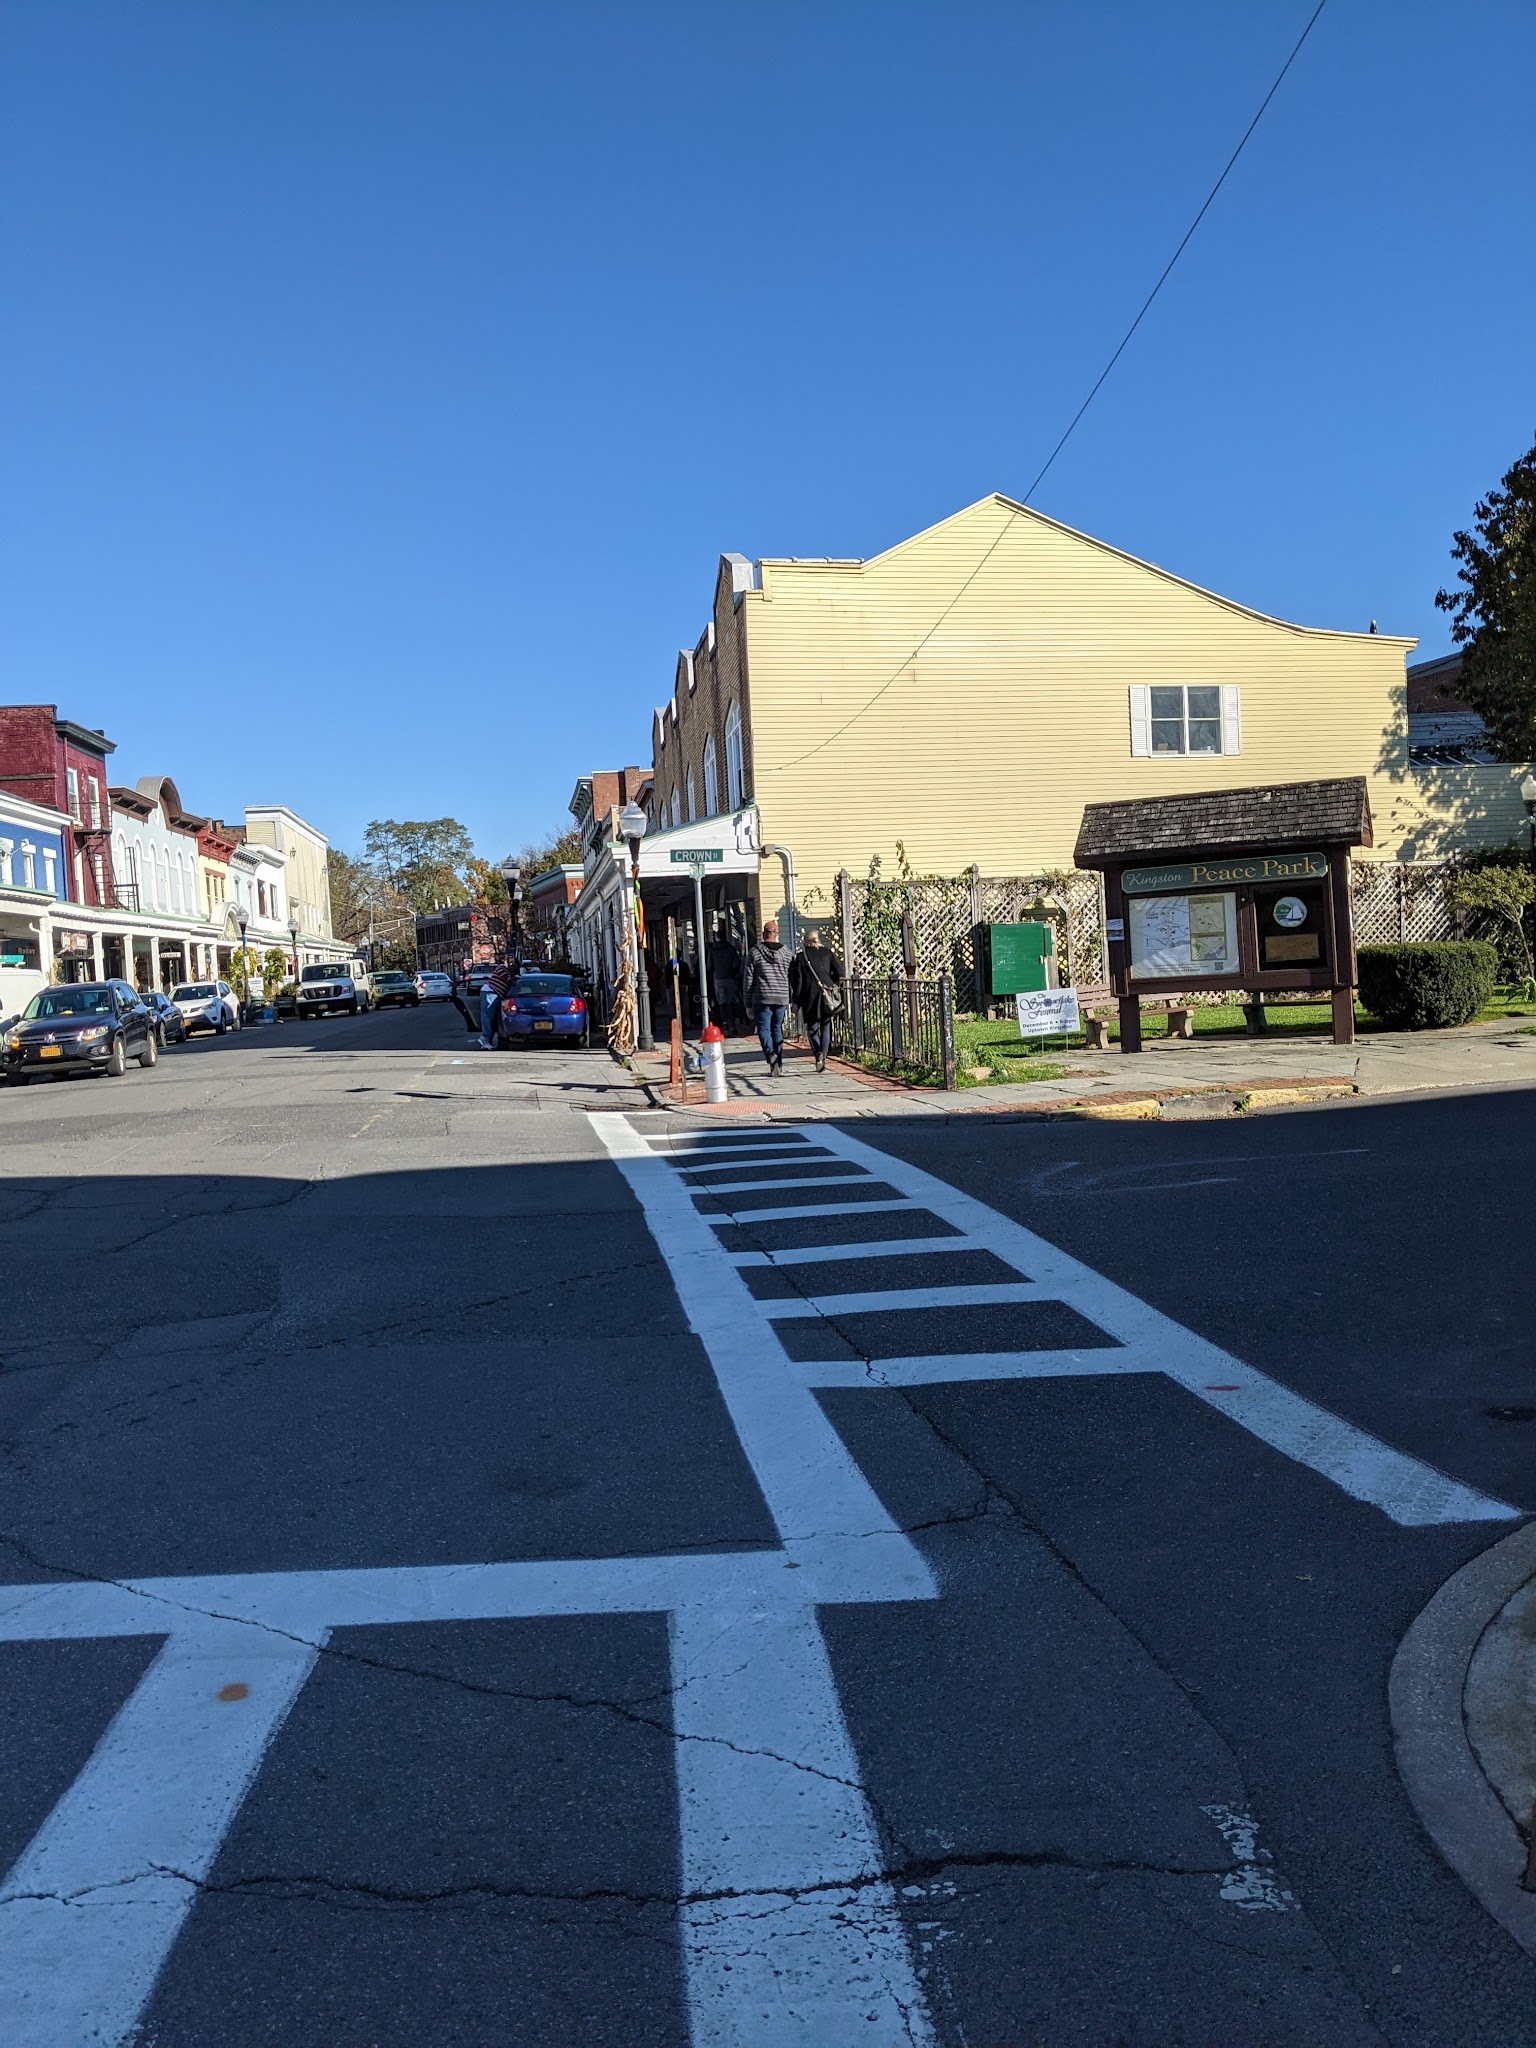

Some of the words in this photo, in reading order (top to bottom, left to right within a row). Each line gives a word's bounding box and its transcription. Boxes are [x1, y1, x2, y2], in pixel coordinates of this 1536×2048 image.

[675, 850, 712, 862] CROWN
[1126, 872, 1183, 888] Kingston
[1190, 866, 1256, 884] Peace
[1261, 856, 1320, 878] Park
[1022, 1021, 1048, 1029] December
